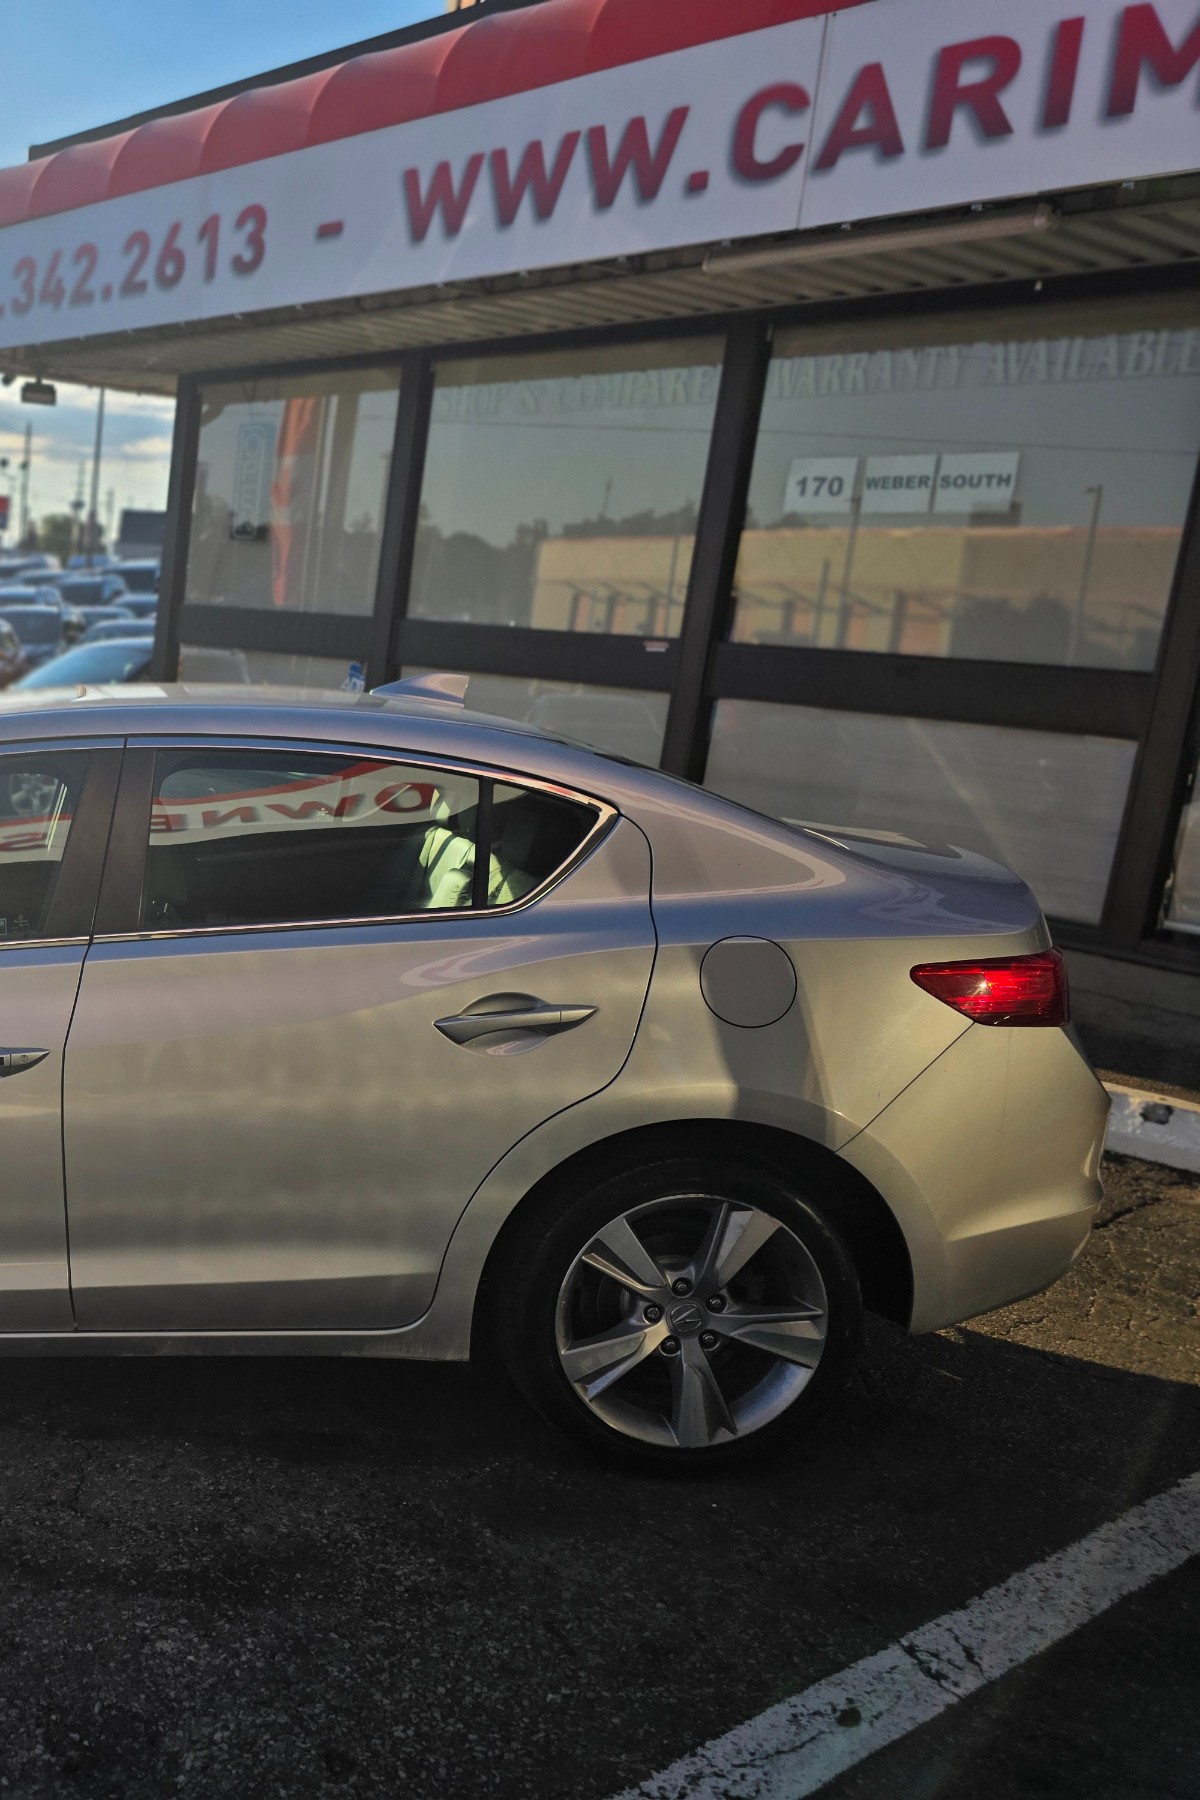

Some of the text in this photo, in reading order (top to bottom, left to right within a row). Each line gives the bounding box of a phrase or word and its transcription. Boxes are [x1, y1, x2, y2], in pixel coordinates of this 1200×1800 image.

[404, 3, 1200, 243] WWW.CARIM
[772, 328, 1200, 398] WARRANTY AVAILABLE
[795, 473, 1013, 498] 170 WEBER SOUTH
